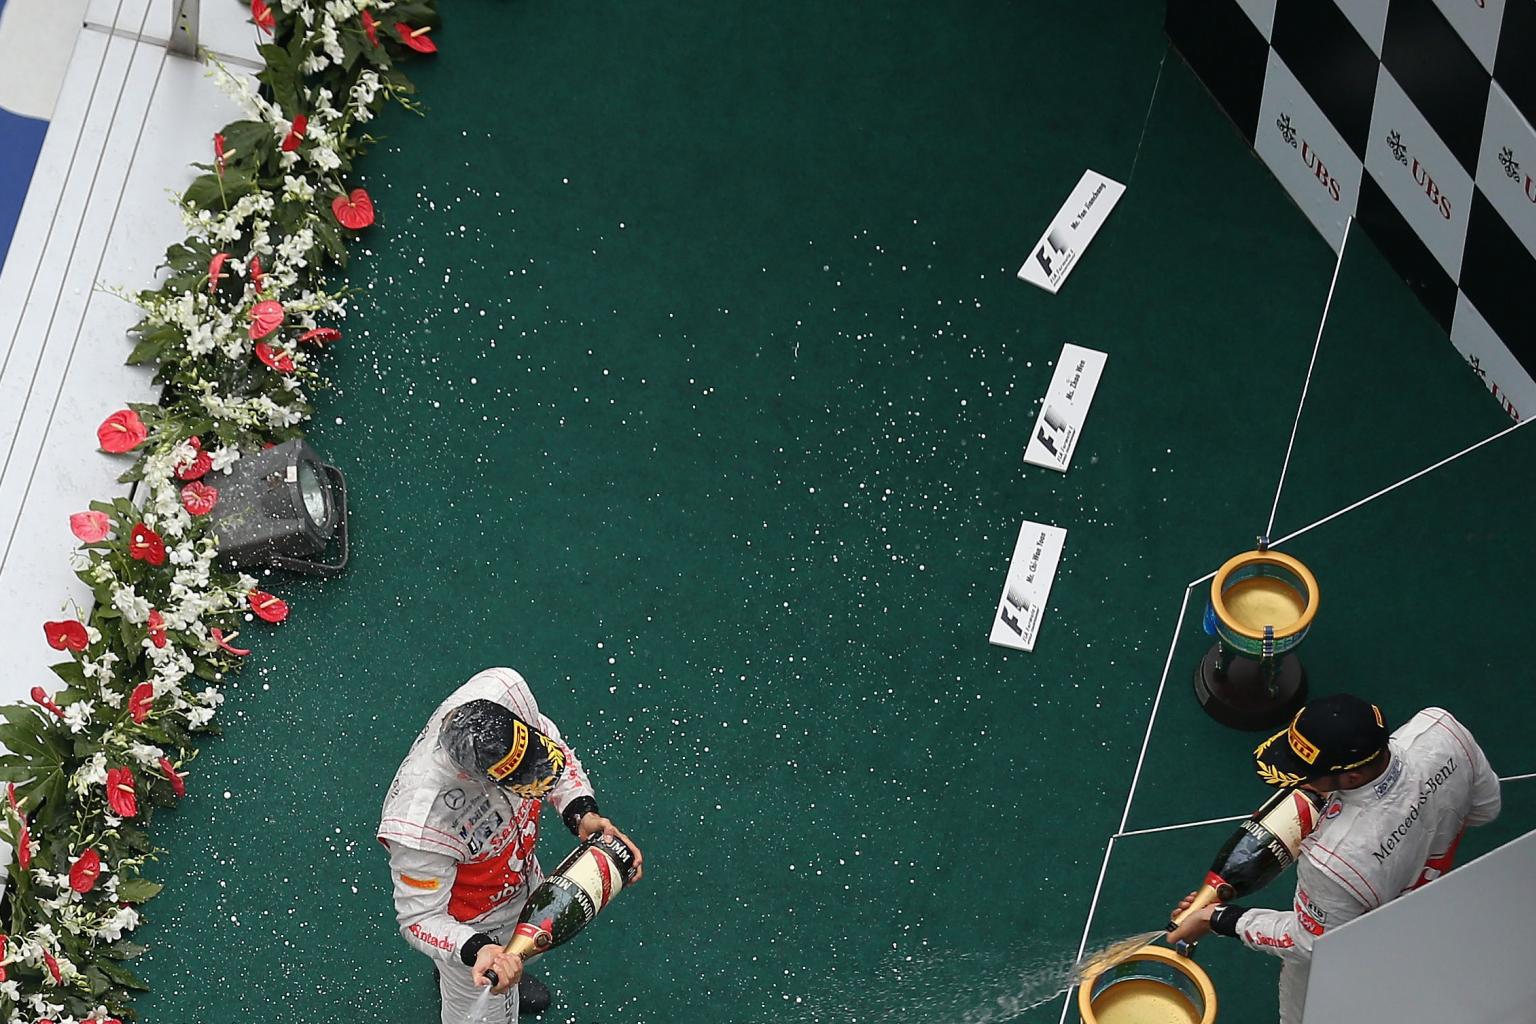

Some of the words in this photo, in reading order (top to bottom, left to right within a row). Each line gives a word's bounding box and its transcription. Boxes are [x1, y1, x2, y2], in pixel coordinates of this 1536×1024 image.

[1300, 139, 1341, 201] UBS
[1411, 158, 1451, 220] UBS
[1035, 228, 1069, 277] F1
[1036, 407, 1067, 457] F1
[1000, 584, 1030, 637] F1
